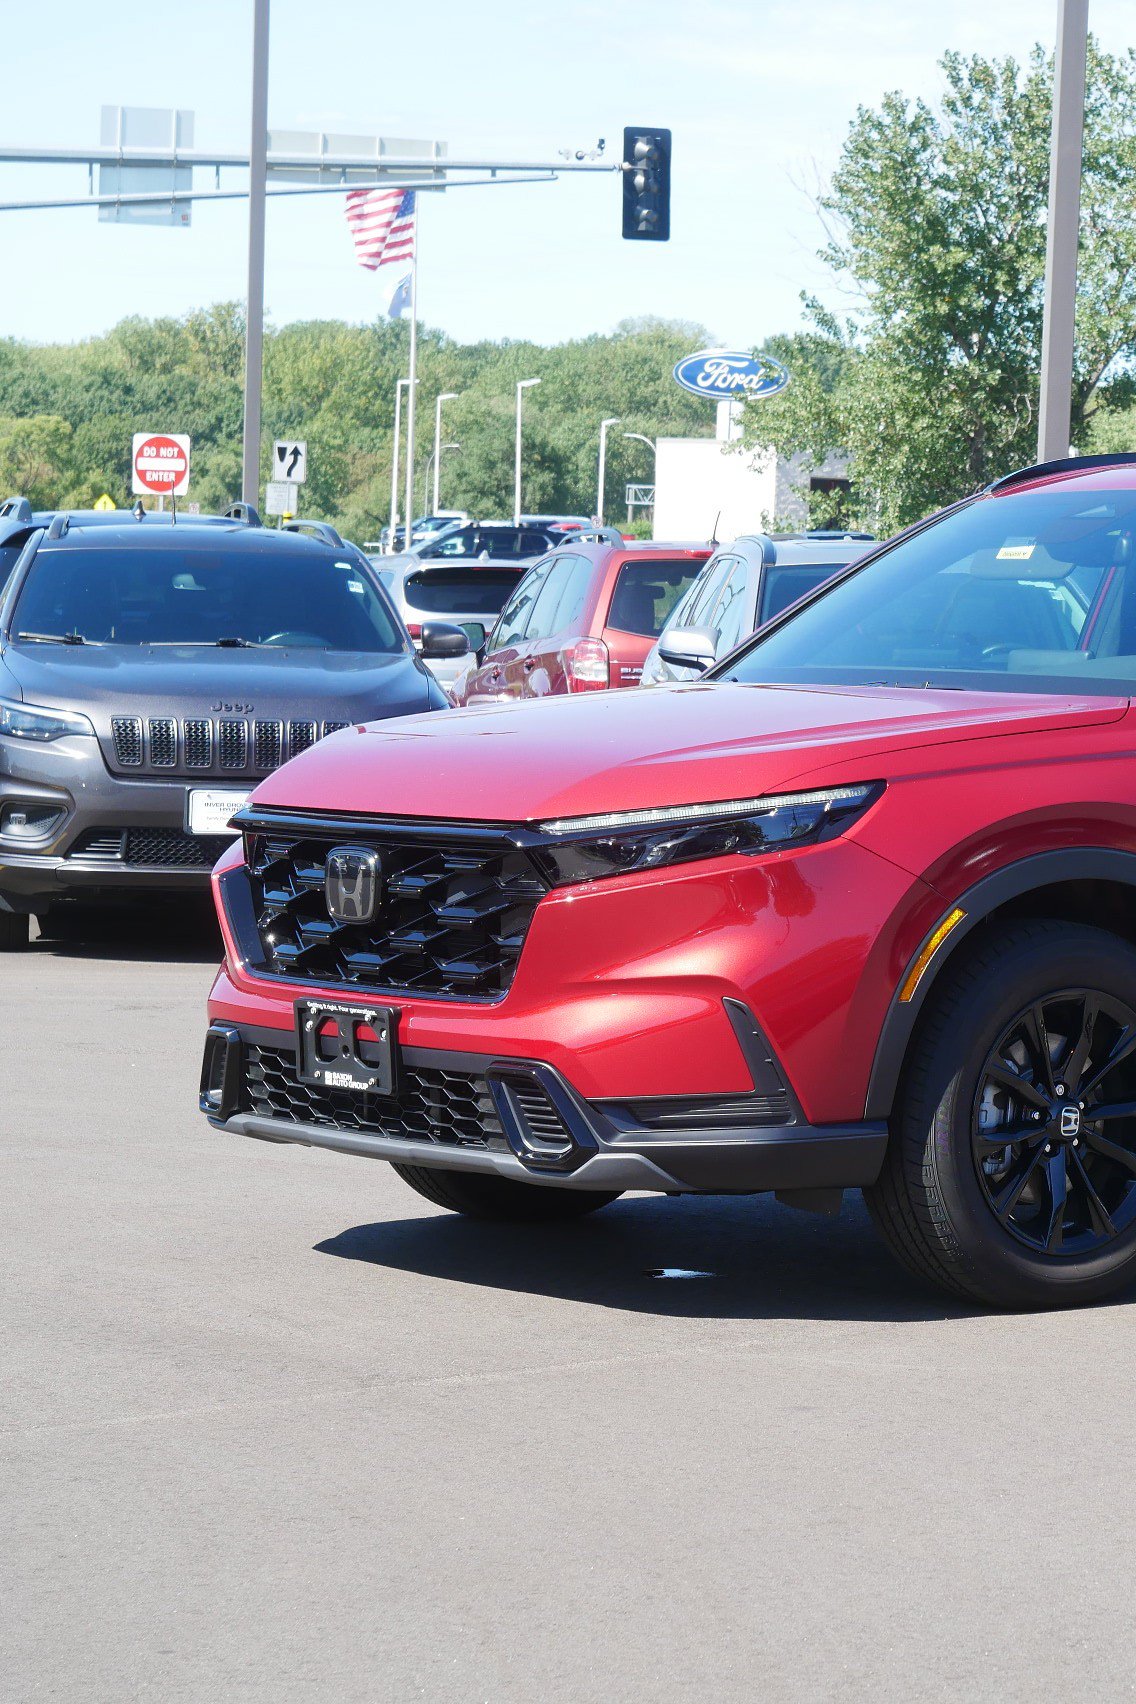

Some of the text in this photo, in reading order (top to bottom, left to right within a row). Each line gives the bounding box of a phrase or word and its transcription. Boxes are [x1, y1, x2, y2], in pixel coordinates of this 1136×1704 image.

[697, 358, 766, 389] Ford
[143, 446, 179, 458] DO NOT
[145, 471, 176, 483] ENTER
[211, 701, 254, 714] Jeep
[333, 1079, 369, 1090] AUTO GROUP
